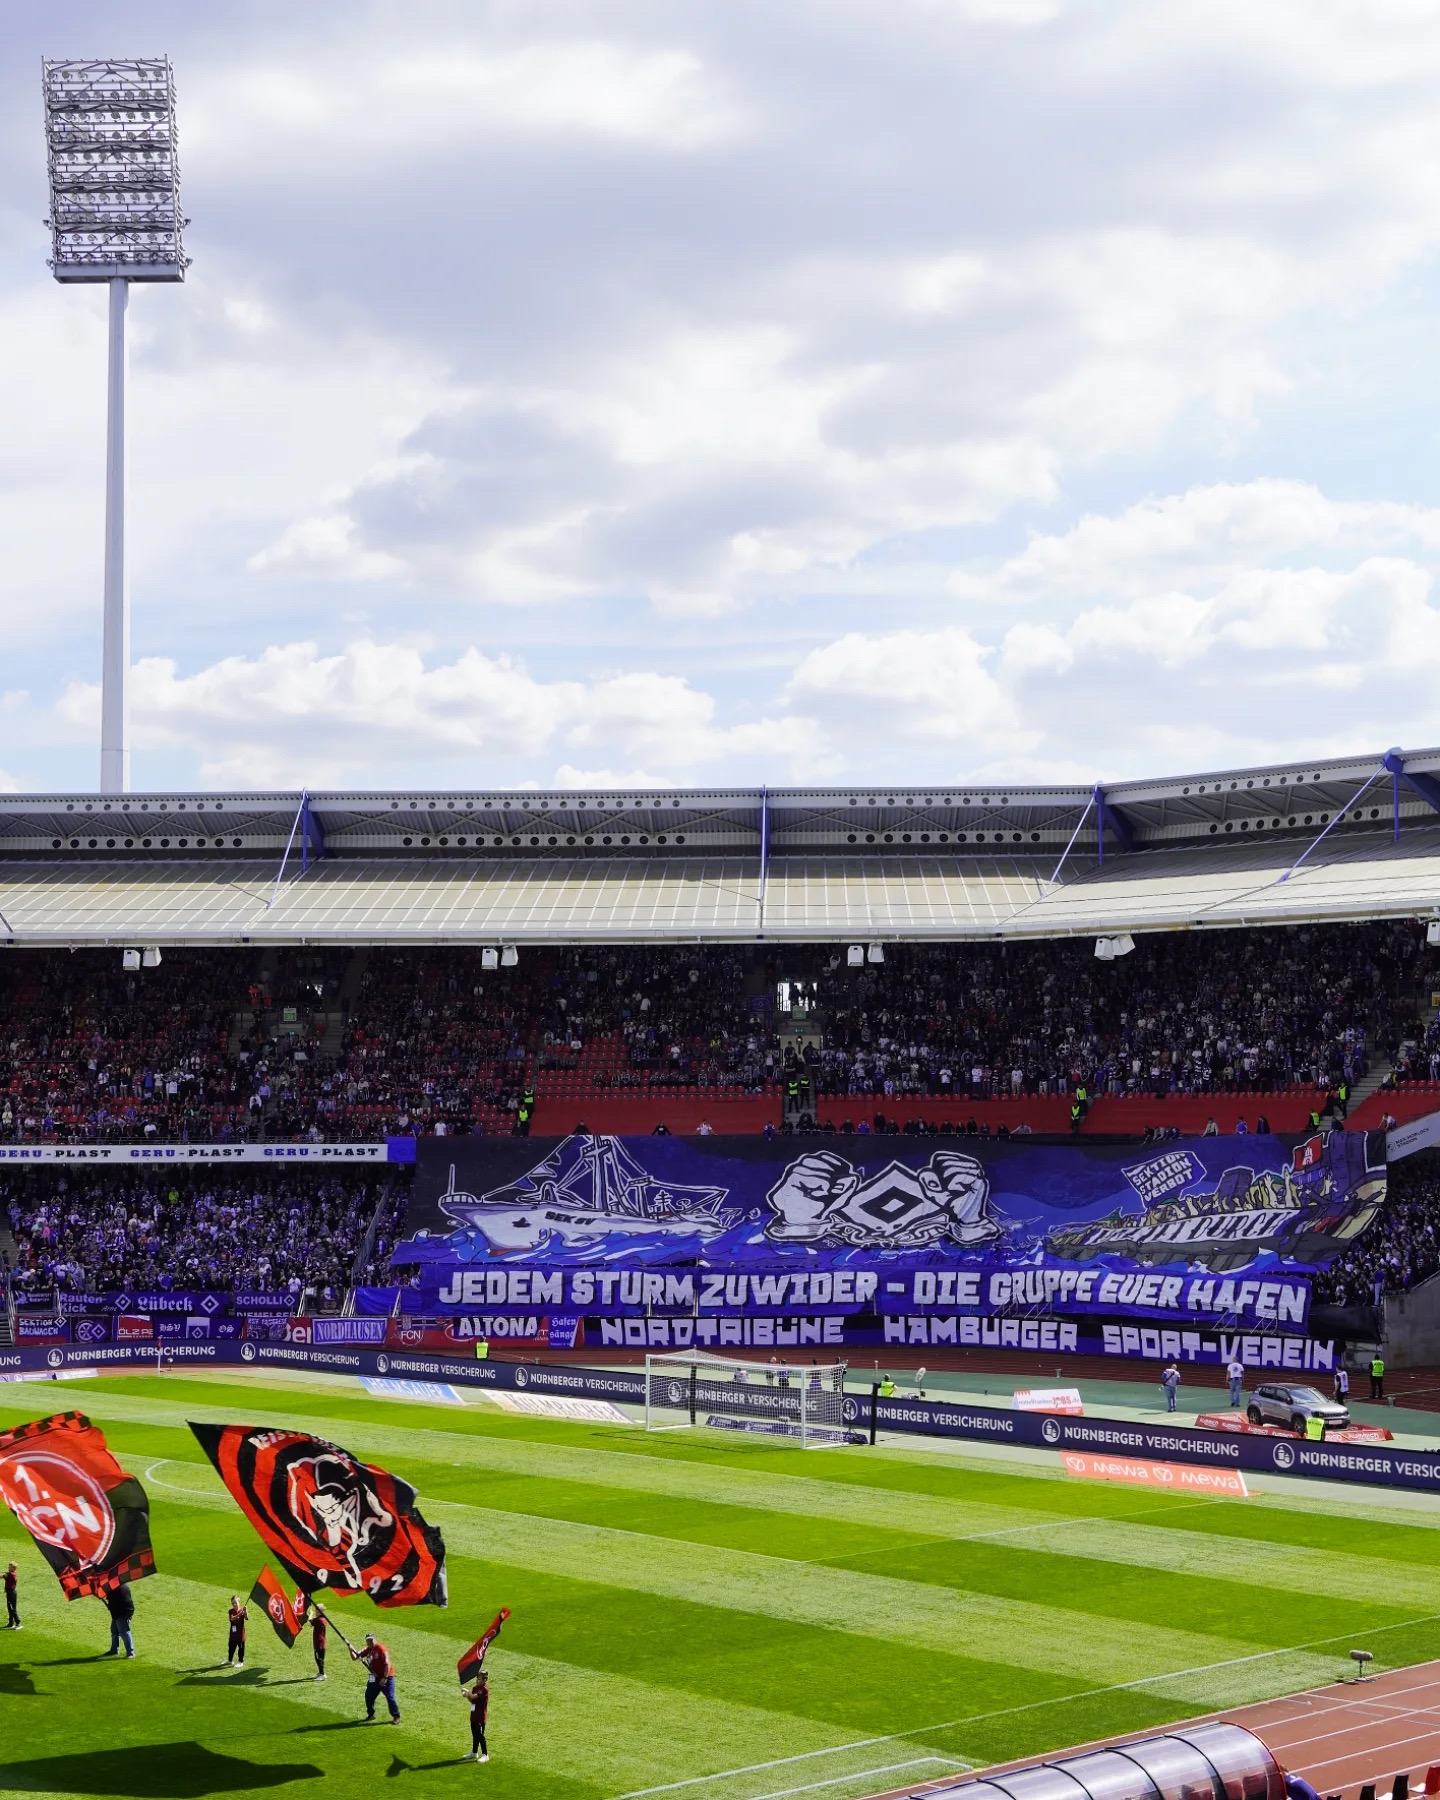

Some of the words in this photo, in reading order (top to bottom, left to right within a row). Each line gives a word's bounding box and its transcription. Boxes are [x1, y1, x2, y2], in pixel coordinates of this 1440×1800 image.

[1132, 1153, 1186, 1186] SEKTION
[1140, 1157, 1193, 1195] STADION
[1144, 1168, 1193, 1202] VERBOT
[137, 1296, 193, 1312] Lübeck
[236, 1296, 283, 1305] SCHOLLI
[439, 1271, 563, 1304] JEDEM
[571, 1271, 694, 1306] STURM
[700, 1272, 878, 1307] ZUWIDER
[914, 1272, 981, 1305] DIE
[989, 1270, 1100, 1305] GRUPPE
[1098, 1272, 1184, 1309] EUER
[1187, 1278, 1307, 1323] HAFEN
[60, 1304, 87, 1313] Kick
[317, 1321, 384, 1340] NORDHAUSEN
[401, 1329, 421, 1340] FCN
[458, 1316, 538, 1337] ALTONA
[600, 1316, 845, 1346] NORDTRIBÜNE
[884, 1315, 1078, 1351] HAMBURGER
[1102, 1324, 1334, 1370] SPORT-VEREIN
[67, 1349, 131, 1361] NÜRNBERGER
[259, 1347, 308, 1361] NÜRNBERGER
[309, 1352, 360, 1366] VERSICHERUNG
[391, 1359, 439, 1373] NÜRNBERGER
[440, 1364, 496, 1379] VERSICHERUNG
[530, 1372, 584, 1388] NÜRNBERGER
[585, 1378, 647, 1394] VERSICHERUNG
[932, 1412, 1014, 1433] VERSICHERUNG
[1064, 1425, 1142, 1447] NÜRNBERGER
[1146, 1435, 1239, 1457] VERSICHERUNG
[1300, 1451, 1391, 1474] NÜRNBERGER
[15, 1495, 101, 1541] CN
